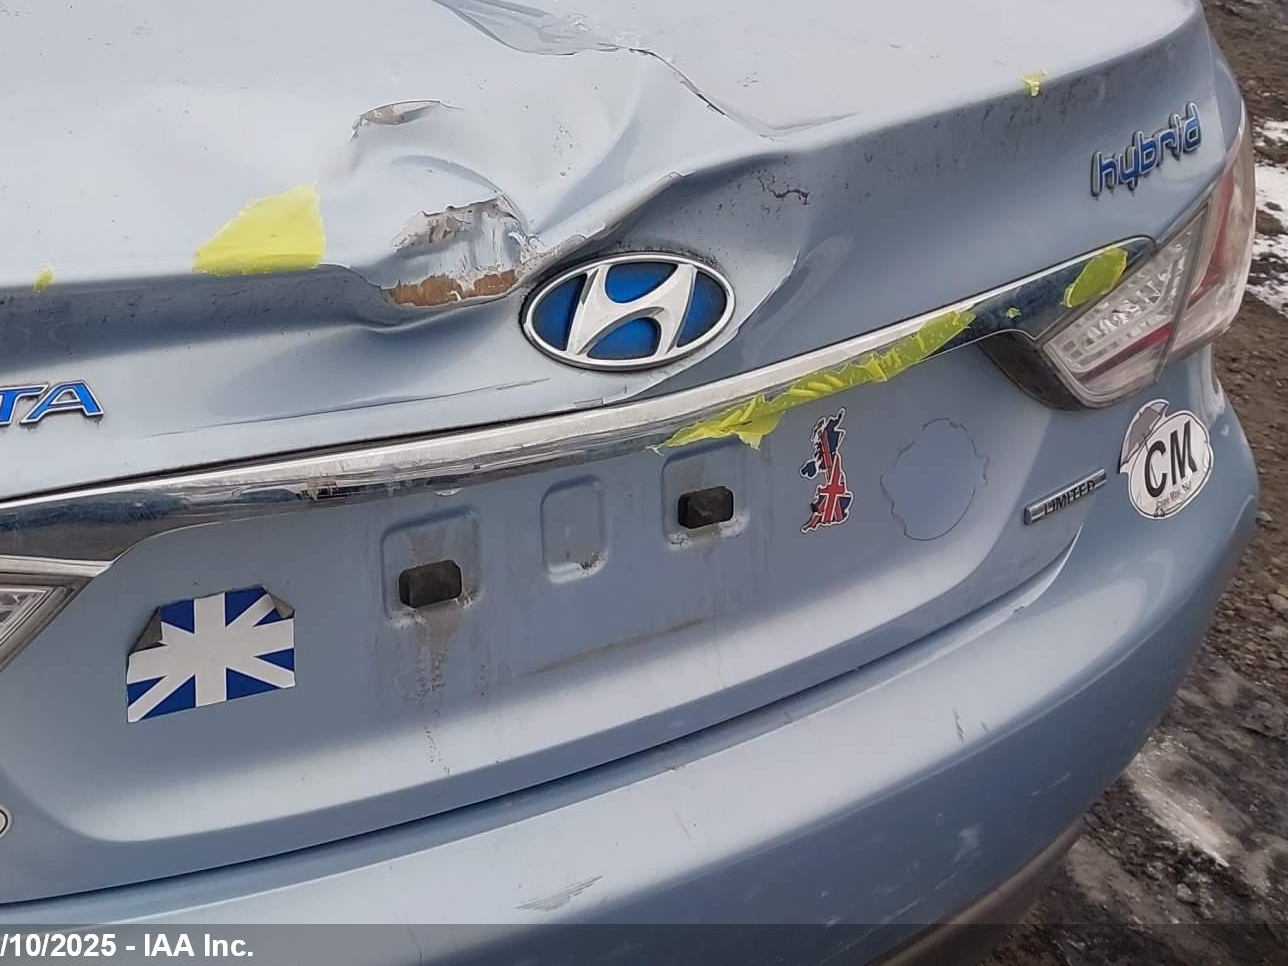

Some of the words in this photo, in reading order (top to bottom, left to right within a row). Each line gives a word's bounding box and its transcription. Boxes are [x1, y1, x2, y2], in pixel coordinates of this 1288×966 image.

[1091, 102, 1201, 196] hybrid
[1044, 480, 1096, 514] LIMITED
[1144, 419, 1197, 498] CM
